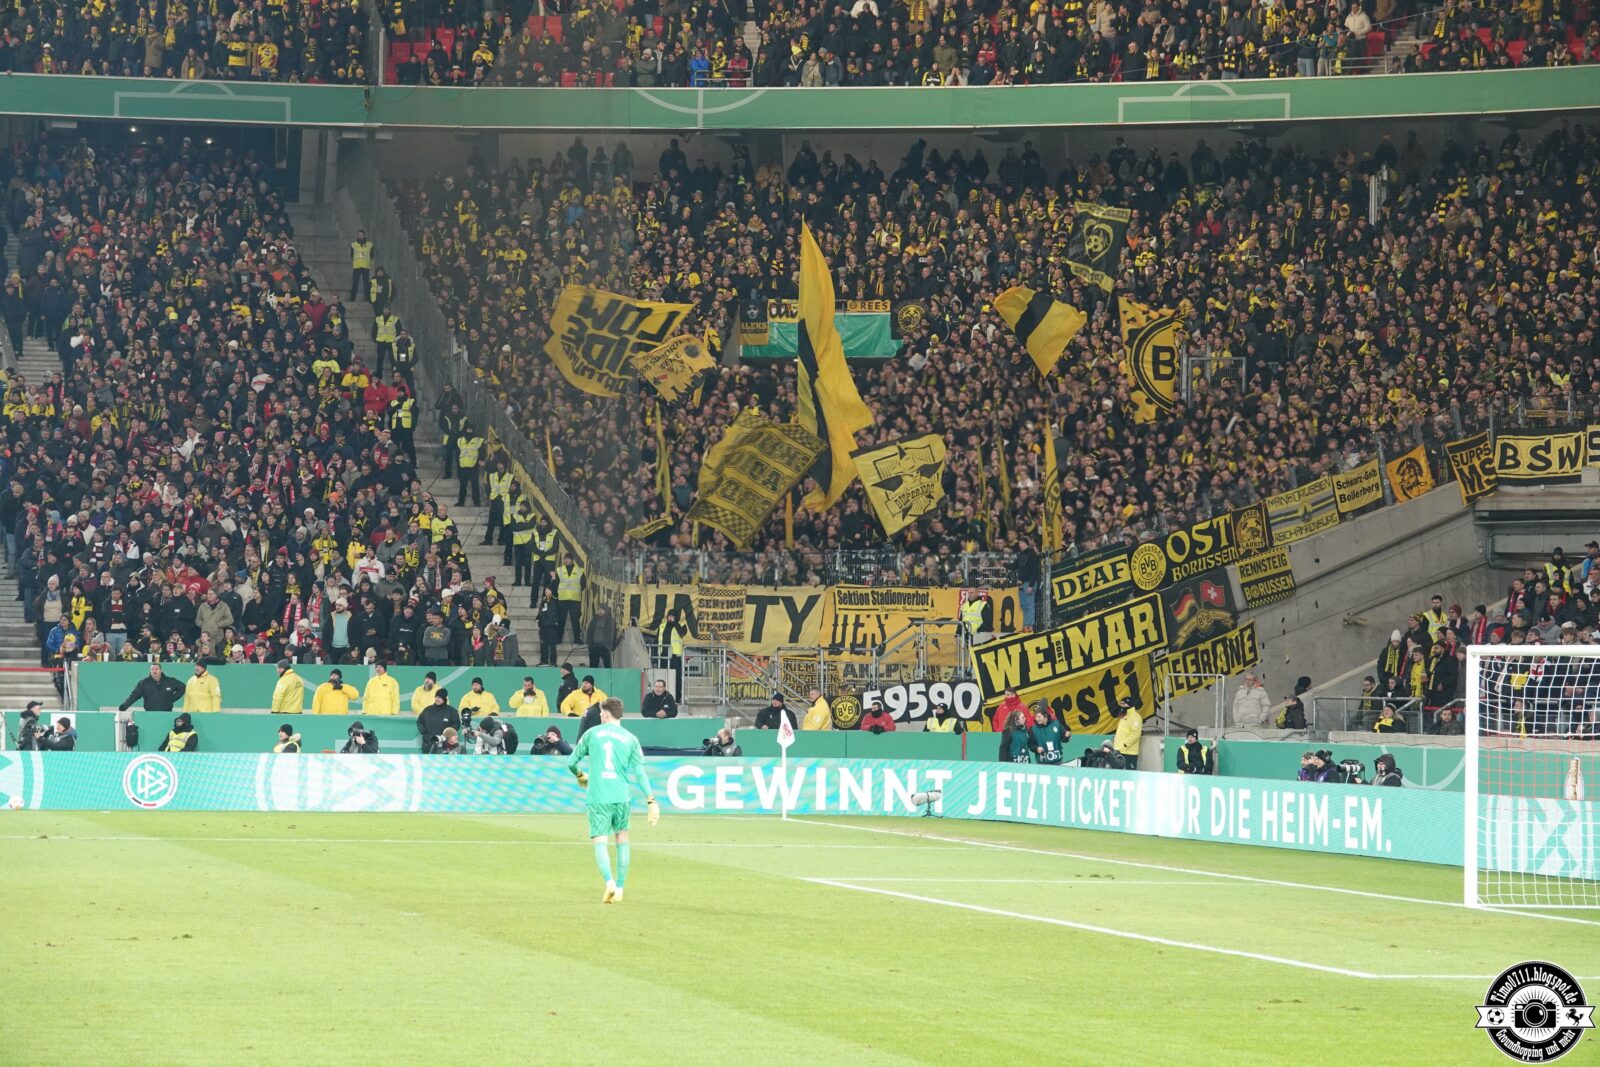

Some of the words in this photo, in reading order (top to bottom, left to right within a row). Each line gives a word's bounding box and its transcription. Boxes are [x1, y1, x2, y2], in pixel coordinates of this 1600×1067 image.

[860, 302, 888, 310] REES
[1451, 442, 1492, 468] SUPPS
[1498, 434, 1582, 472] BSW
[1166, 514, 1232, 563] OST
[1055, 558, 1128, 601] DEAF
[1140, 556, 1157, 575] BVB
[1239, 552, 1288, 578] RENNSTEIG
[836, 590, 870, 606] Sektion
[870, 590, 930, 606] Stadionverbot
[630, 593, 822, 644] UNTY
[980, 602, 1159, 693] WEIMAR
[838, 703, 854, 717] BVB
[862, 682, 981, 721] 59590
[603, 741, 615, 771] 1
[666, 765, 954, 812] GEWINNT
[967, 771, 1051, 819] JETZT
[1210, 786, 1250, 840] DIE
[1262, 790, 1392, 852] HEIM-EM.
